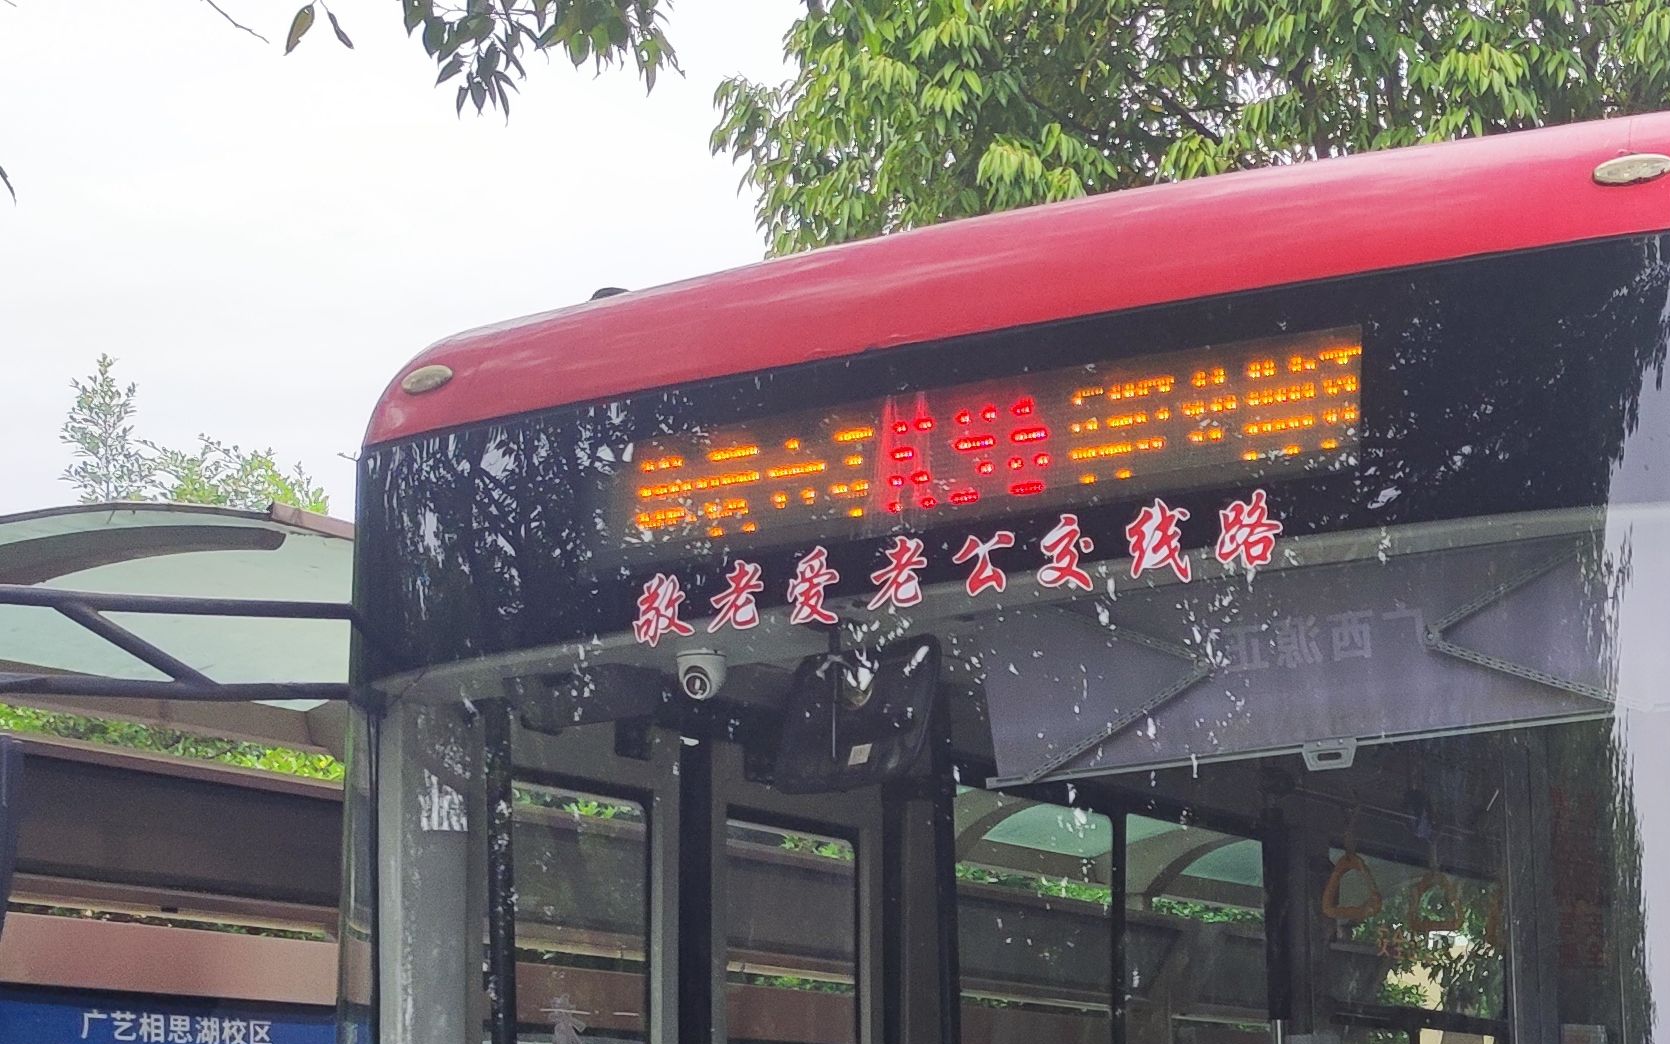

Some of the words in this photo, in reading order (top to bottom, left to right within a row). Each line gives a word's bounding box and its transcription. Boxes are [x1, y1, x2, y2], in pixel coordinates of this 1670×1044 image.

[633, 489, 1284, 646] 敬老爱老公交线路
